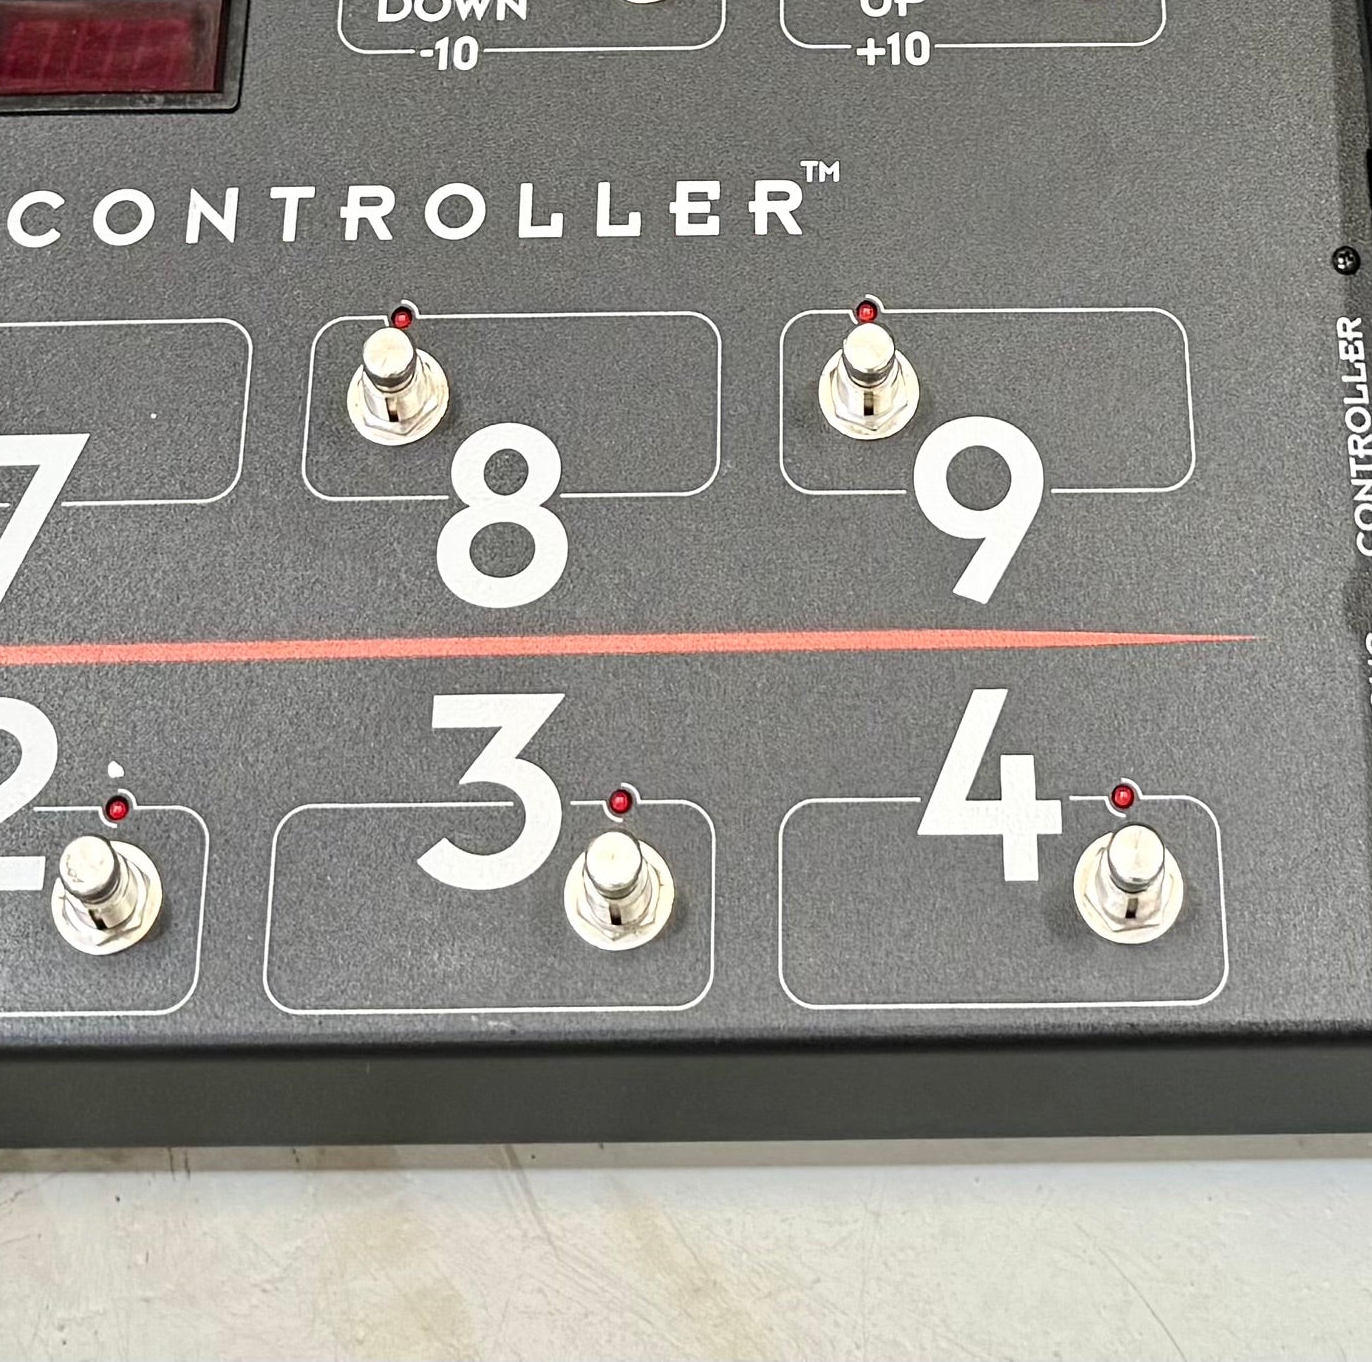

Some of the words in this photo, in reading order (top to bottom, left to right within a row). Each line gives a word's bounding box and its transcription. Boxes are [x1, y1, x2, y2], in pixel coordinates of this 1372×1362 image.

[419, 35, 481, 72] -10
[855, 32, 932, 69] +10
[435, 421, 569, 608] 8
[912, 415, 1046, 605] 9
[417, 692, 566, 891] 3
[916, 687, 1063, 882] 4
